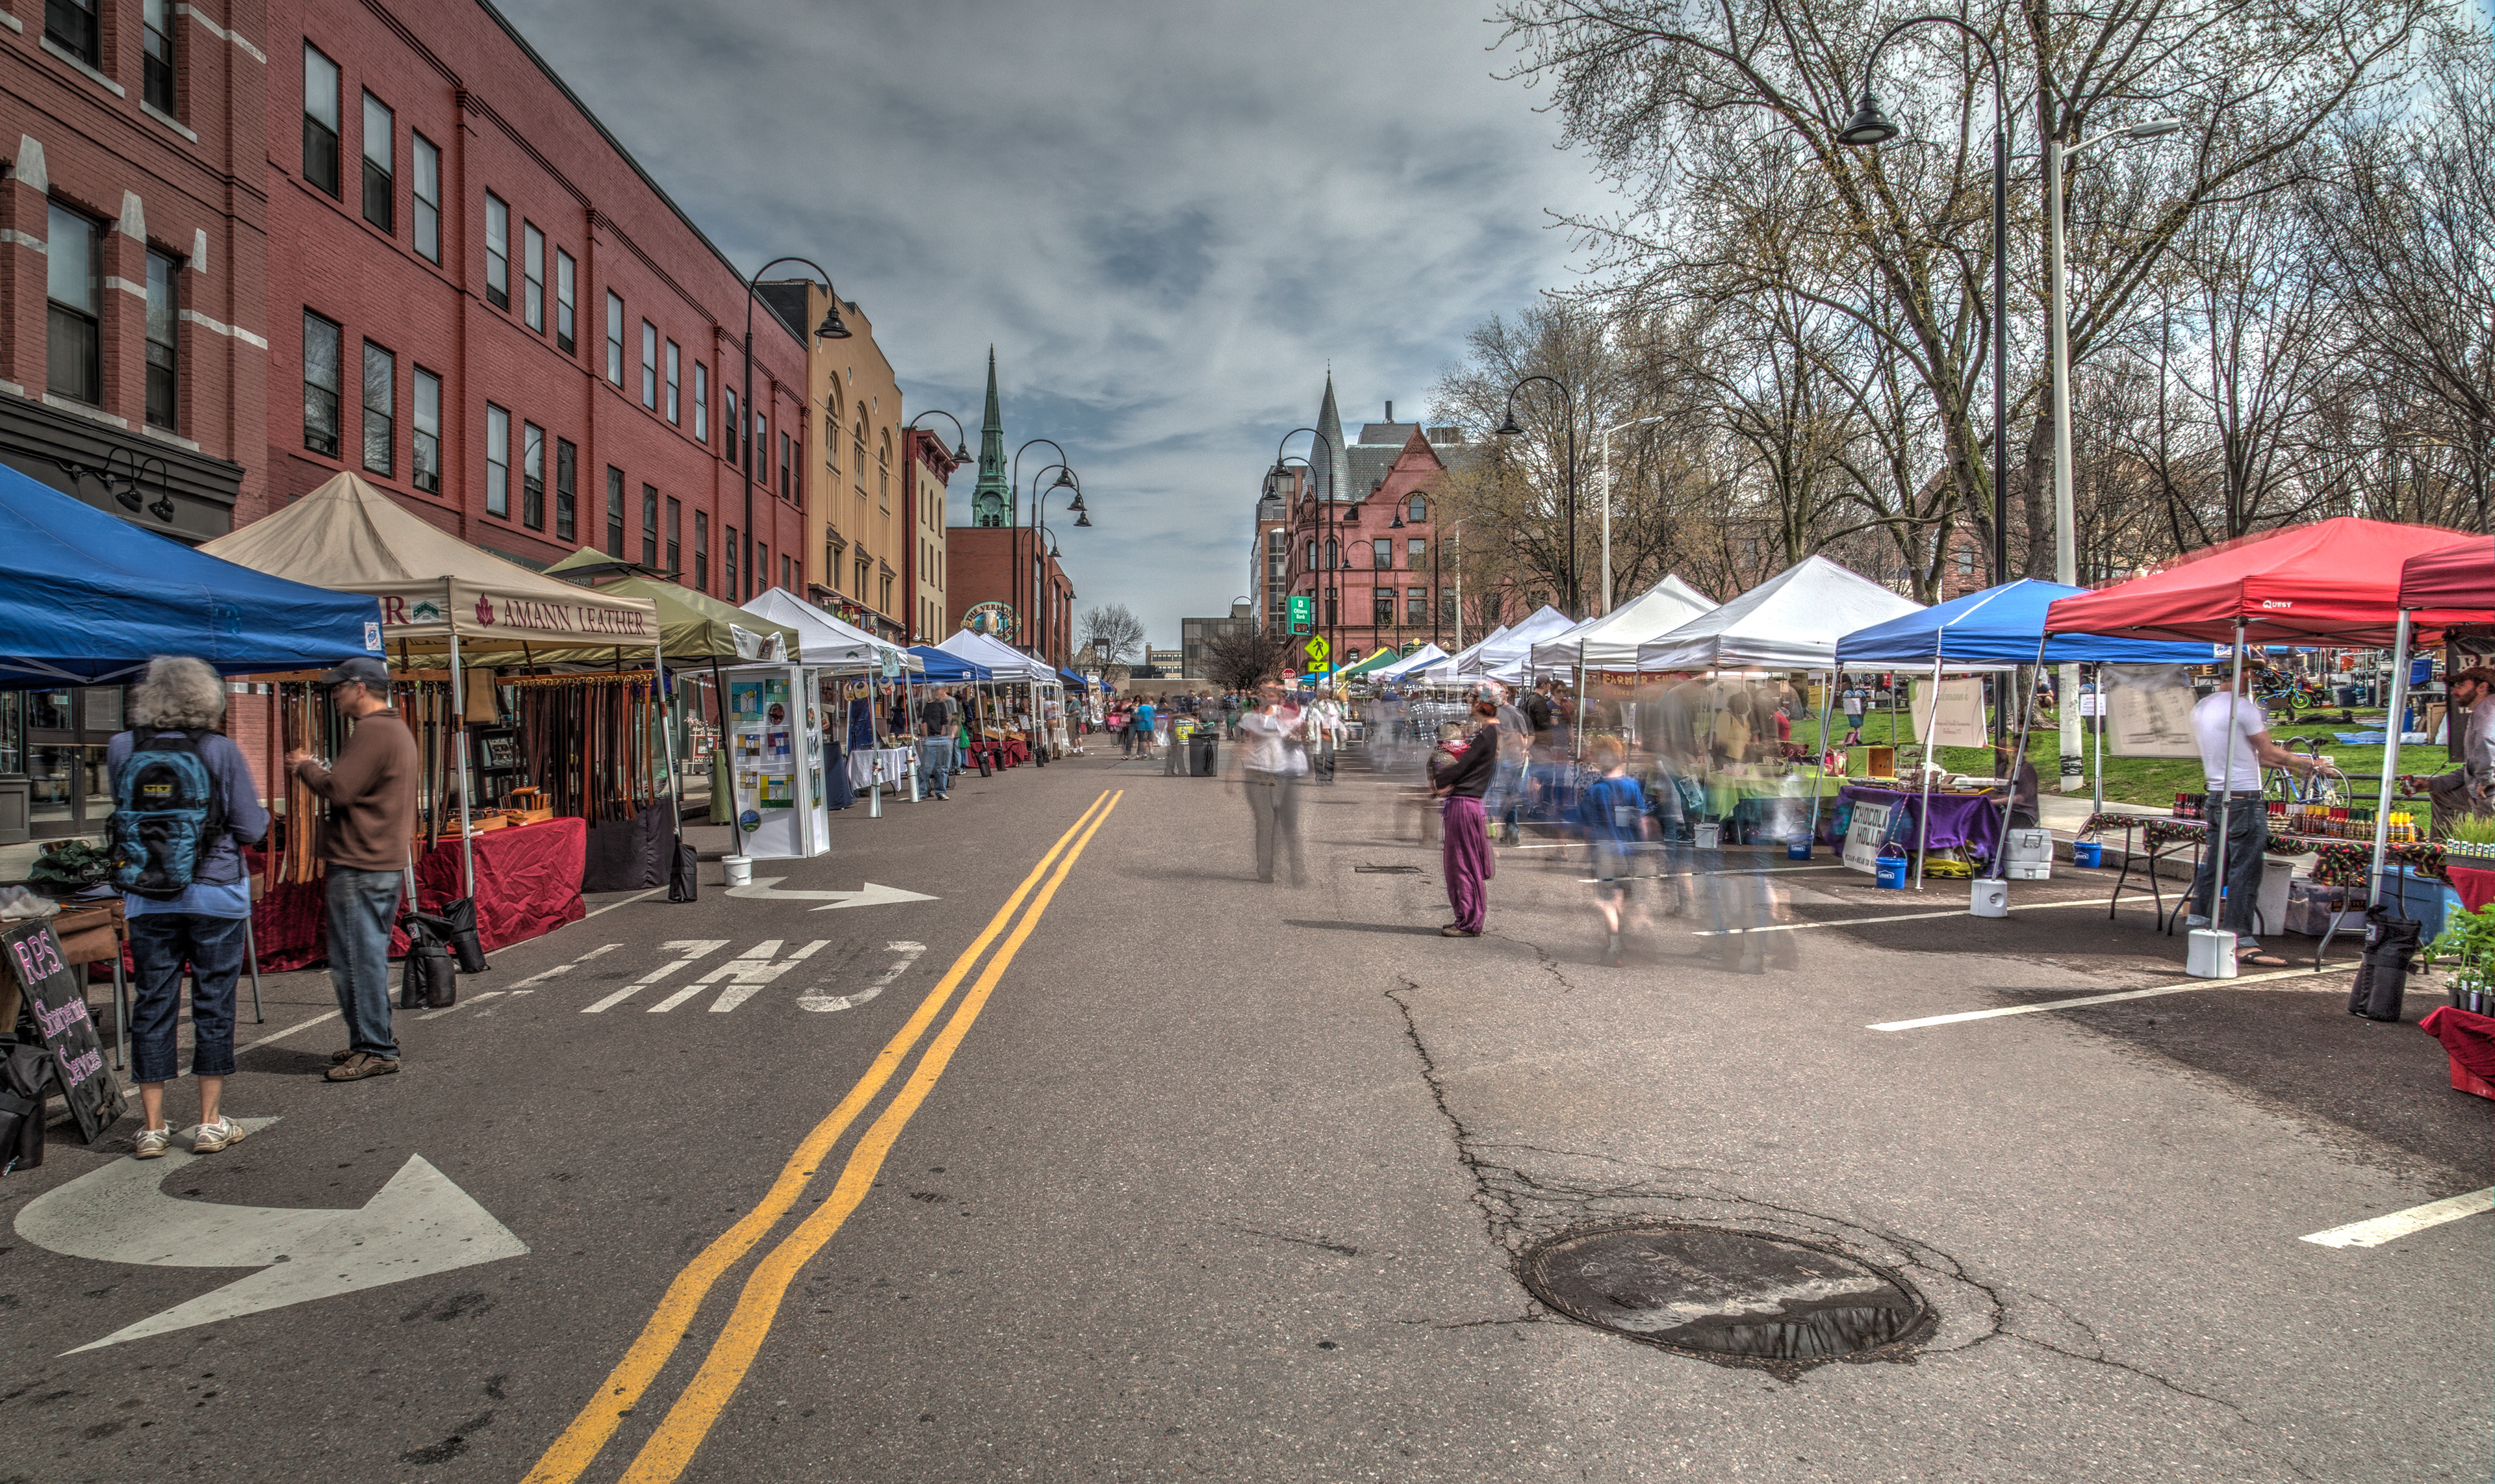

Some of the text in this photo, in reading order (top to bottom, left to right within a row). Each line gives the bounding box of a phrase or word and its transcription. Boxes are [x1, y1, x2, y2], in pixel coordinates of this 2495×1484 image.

[503, 599, 646, 635] AMANN LEATHER
[966, 604, 1014, 622] THE VERMON
[2262, 600, 2292, 609] QUEST
[1853, 806, 1888, 829] CHOCOLA
[35, 996, 93, 1040] Sharpening
[59, 1045, 103, 1088] Services
